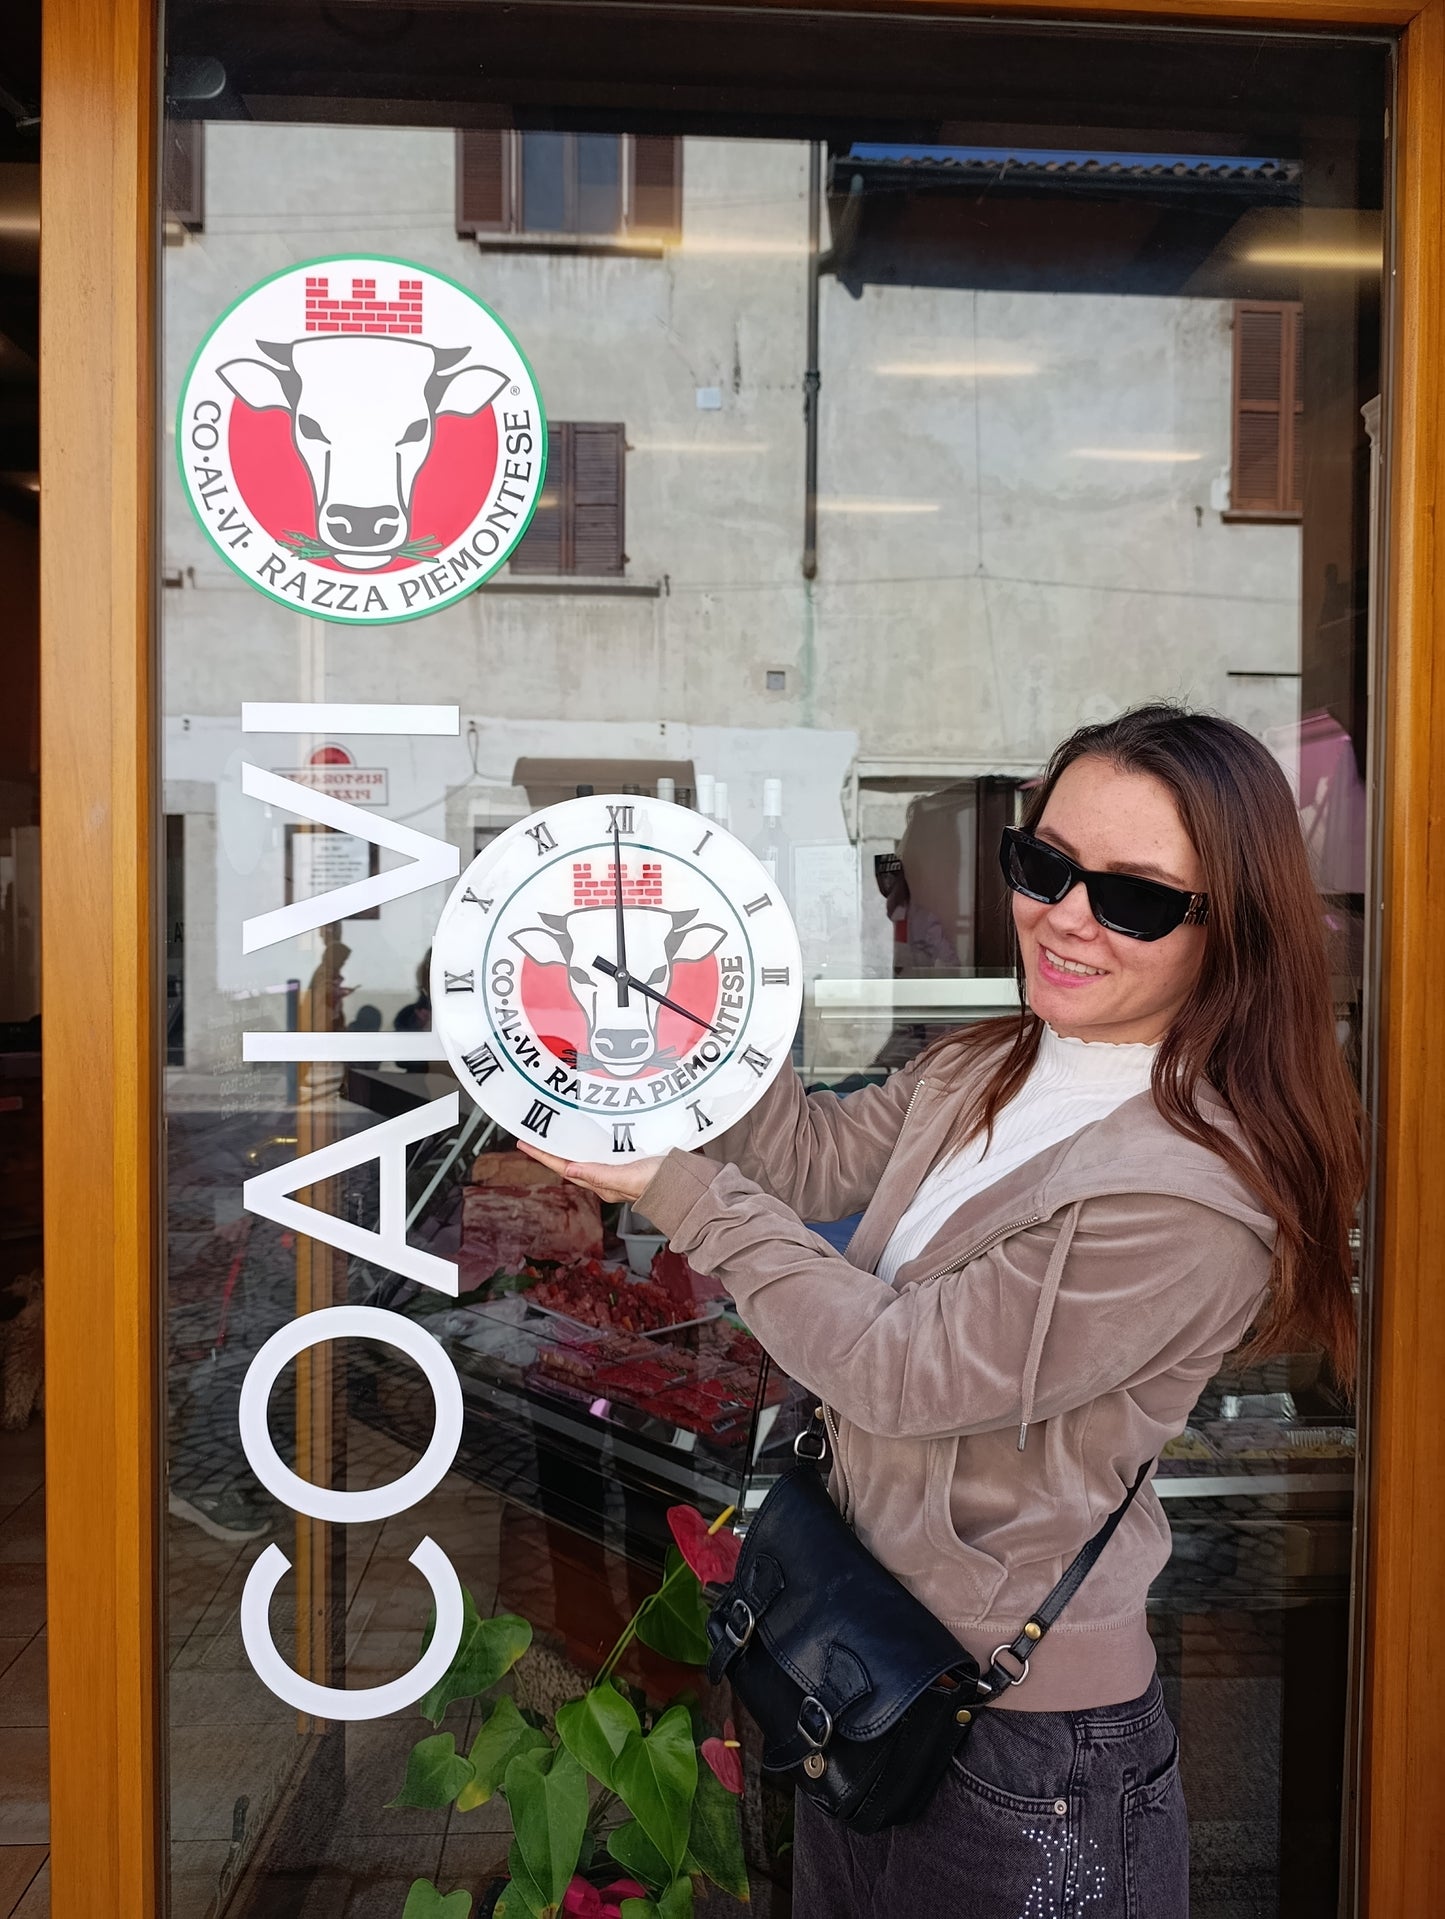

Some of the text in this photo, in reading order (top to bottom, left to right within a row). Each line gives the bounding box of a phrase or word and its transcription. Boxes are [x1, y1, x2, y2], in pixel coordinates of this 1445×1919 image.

[257, 552, 389, 613] RAZZA
[398, 409, 533, 607] PIEMONTESE
[605, 805, 635, 834] XII
[525, 821, 559, 856] XI
[461, 887, 494, 914] X
[743, 893, 773, 917] II
[444, 969, 475, 994] IX
[761, 966, 790, 986] III
[544, 1065, 646, 1108] RAZZA
[648, 955, 744, 1103] PIEMONTESE
[520, 1098, 561, 1138] VII
[685, 1099, 714, 1133] V
[240, 701, 462, 1720] COALVI
